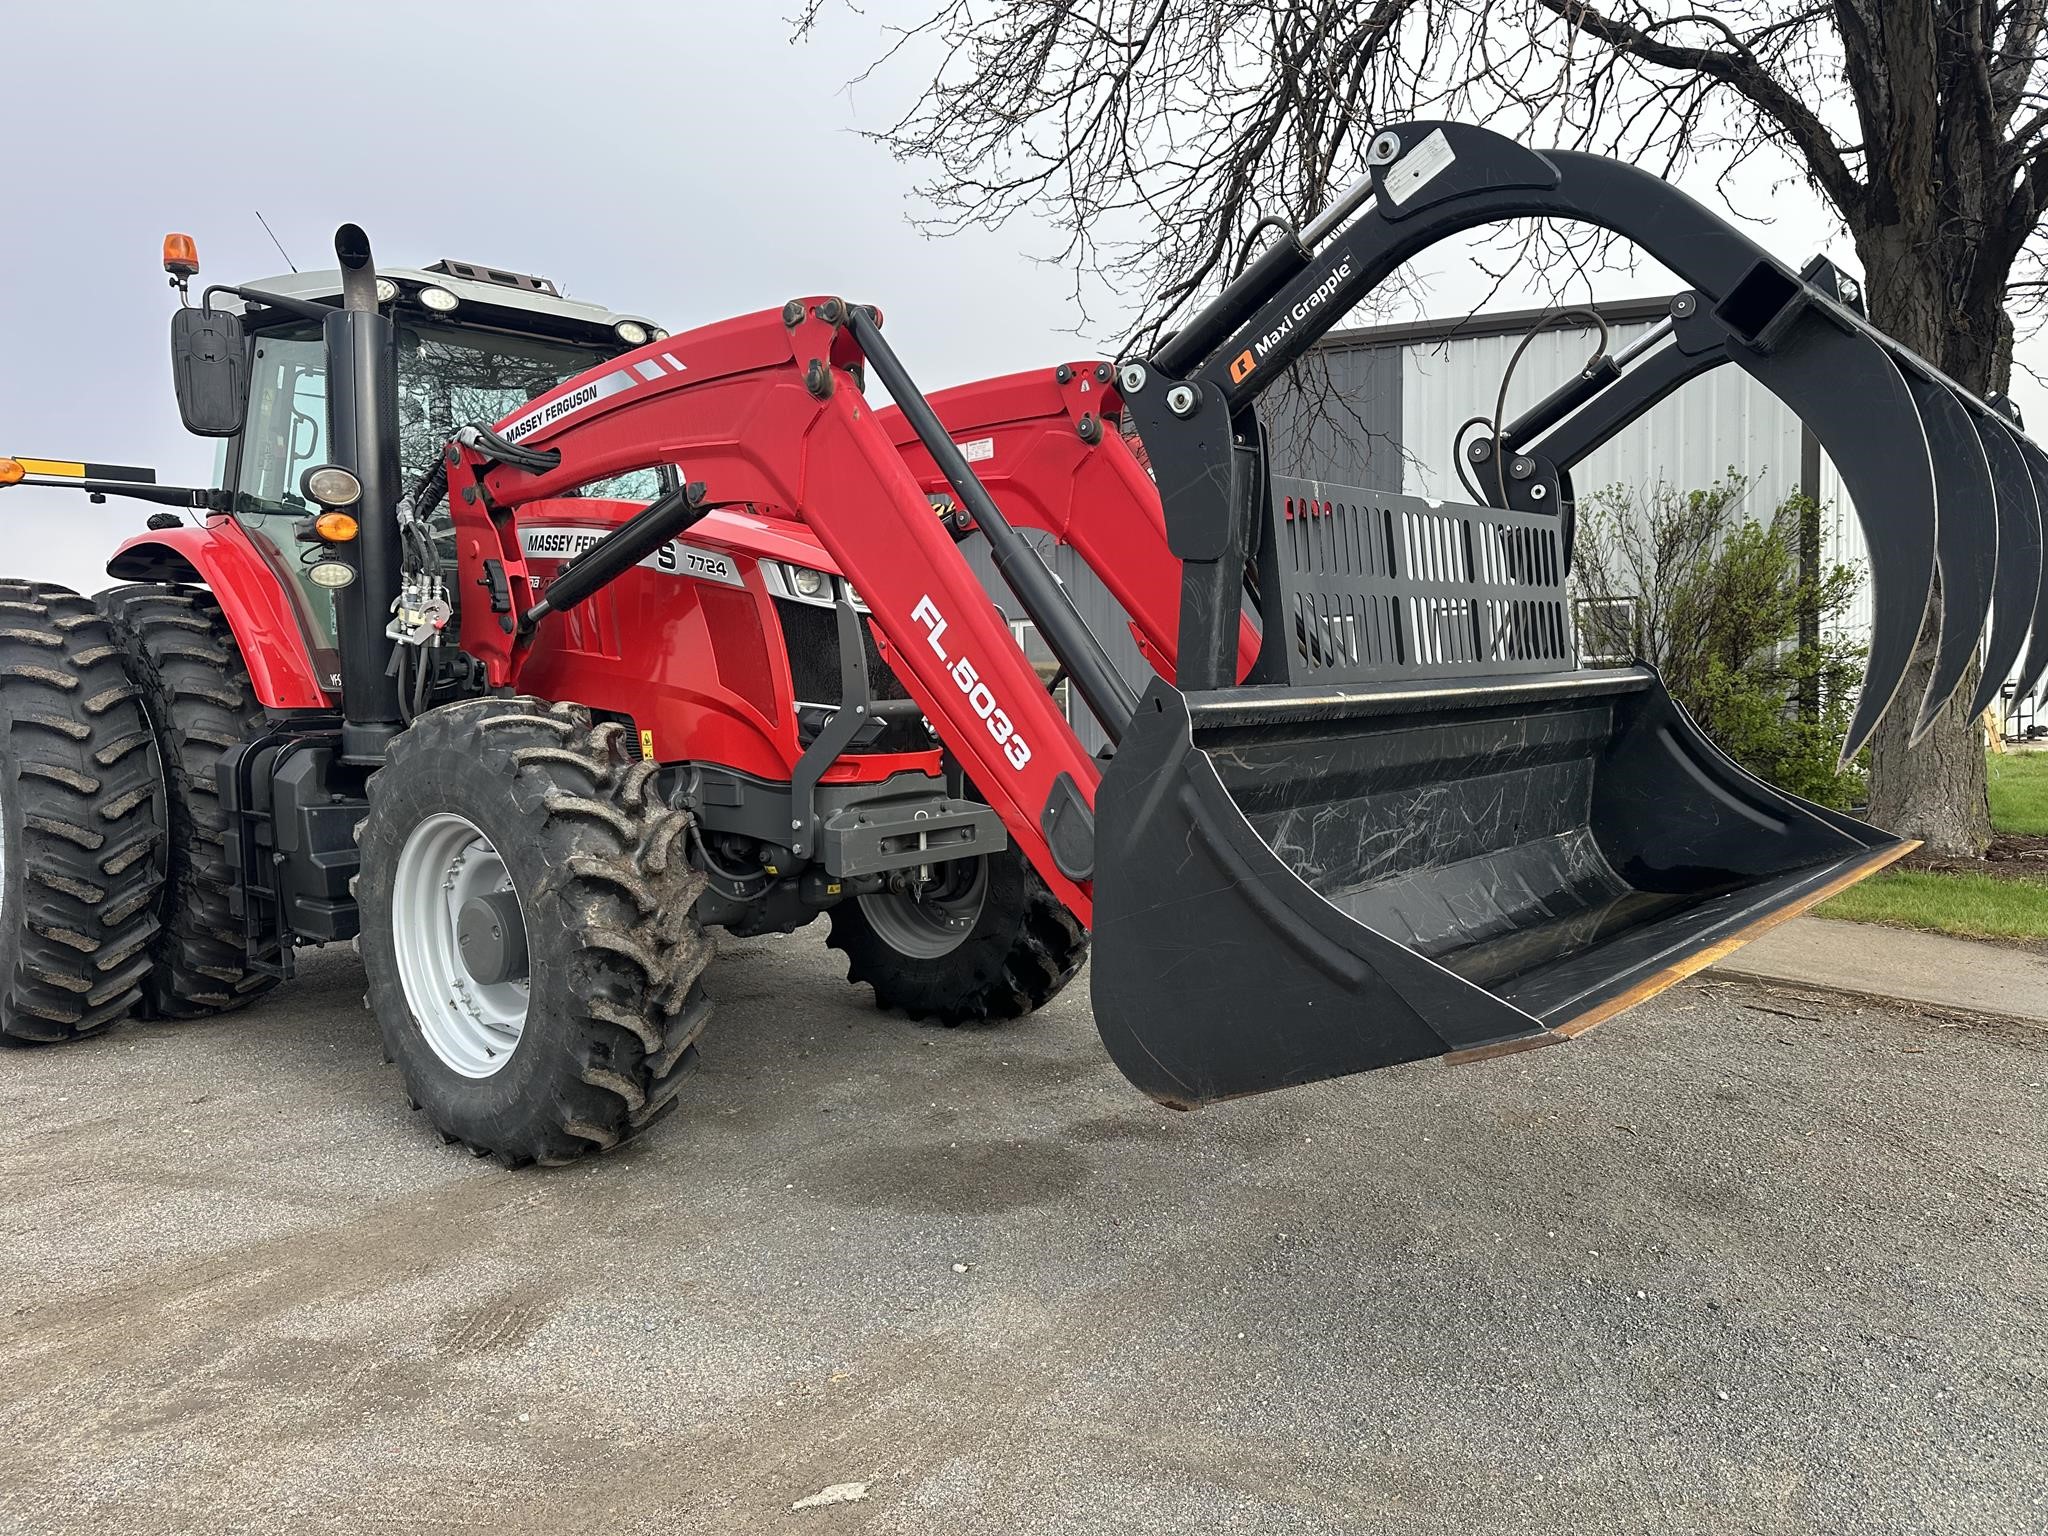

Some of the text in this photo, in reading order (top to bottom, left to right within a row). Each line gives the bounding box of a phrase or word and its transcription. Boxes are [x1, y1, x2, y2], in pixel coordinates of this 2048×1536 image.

[1254, 314, 1294, 357] Maxi
[505, 384, 598, 443] MASSEY FERGUSON
[527, 534, 574, 552] MASSEY
[657, 541, 728, 577] S 7724
[910, 594, 1032, 771] FL.5033
